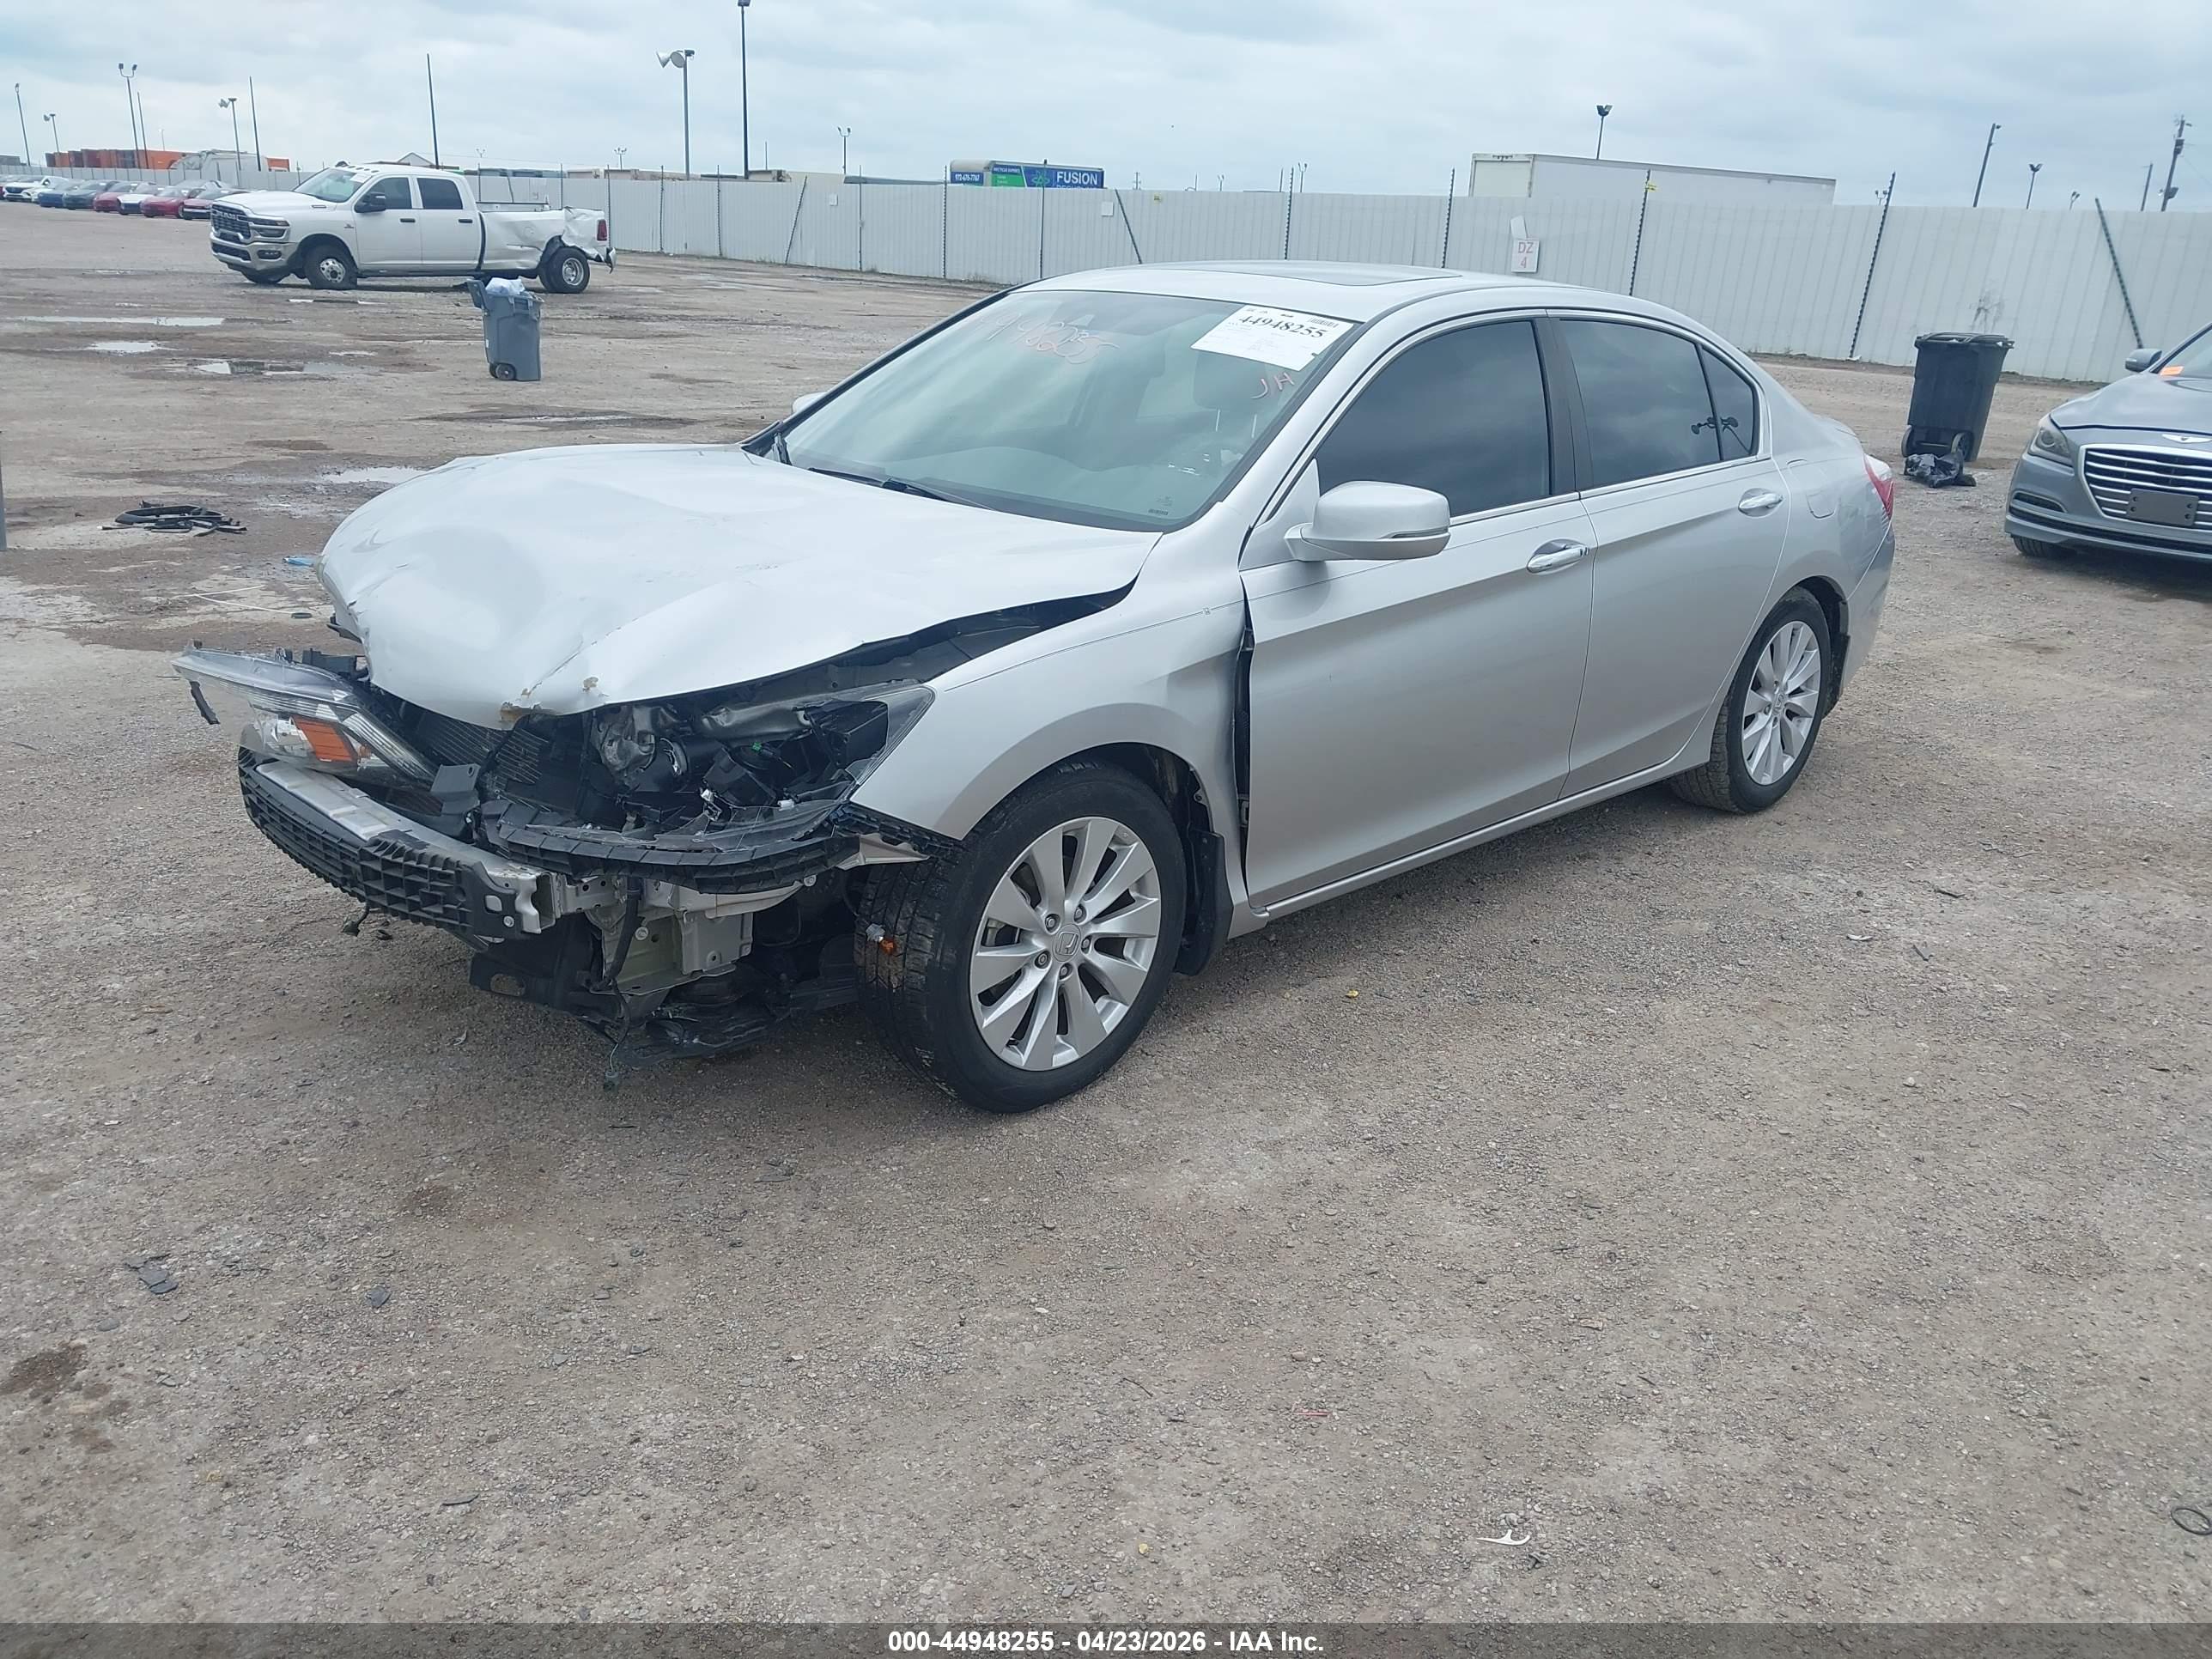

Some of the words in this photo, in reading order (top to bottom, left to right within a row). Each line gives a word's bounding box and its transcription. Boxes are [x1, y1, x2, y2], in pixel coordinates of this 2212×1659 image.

[1056, 171, 1098, 185] FUSION
[1517, 241, 1534, 253] DZ
[1520, 257, 1527, 268] 4
[1237, 314, 1329, 338] 44948255
